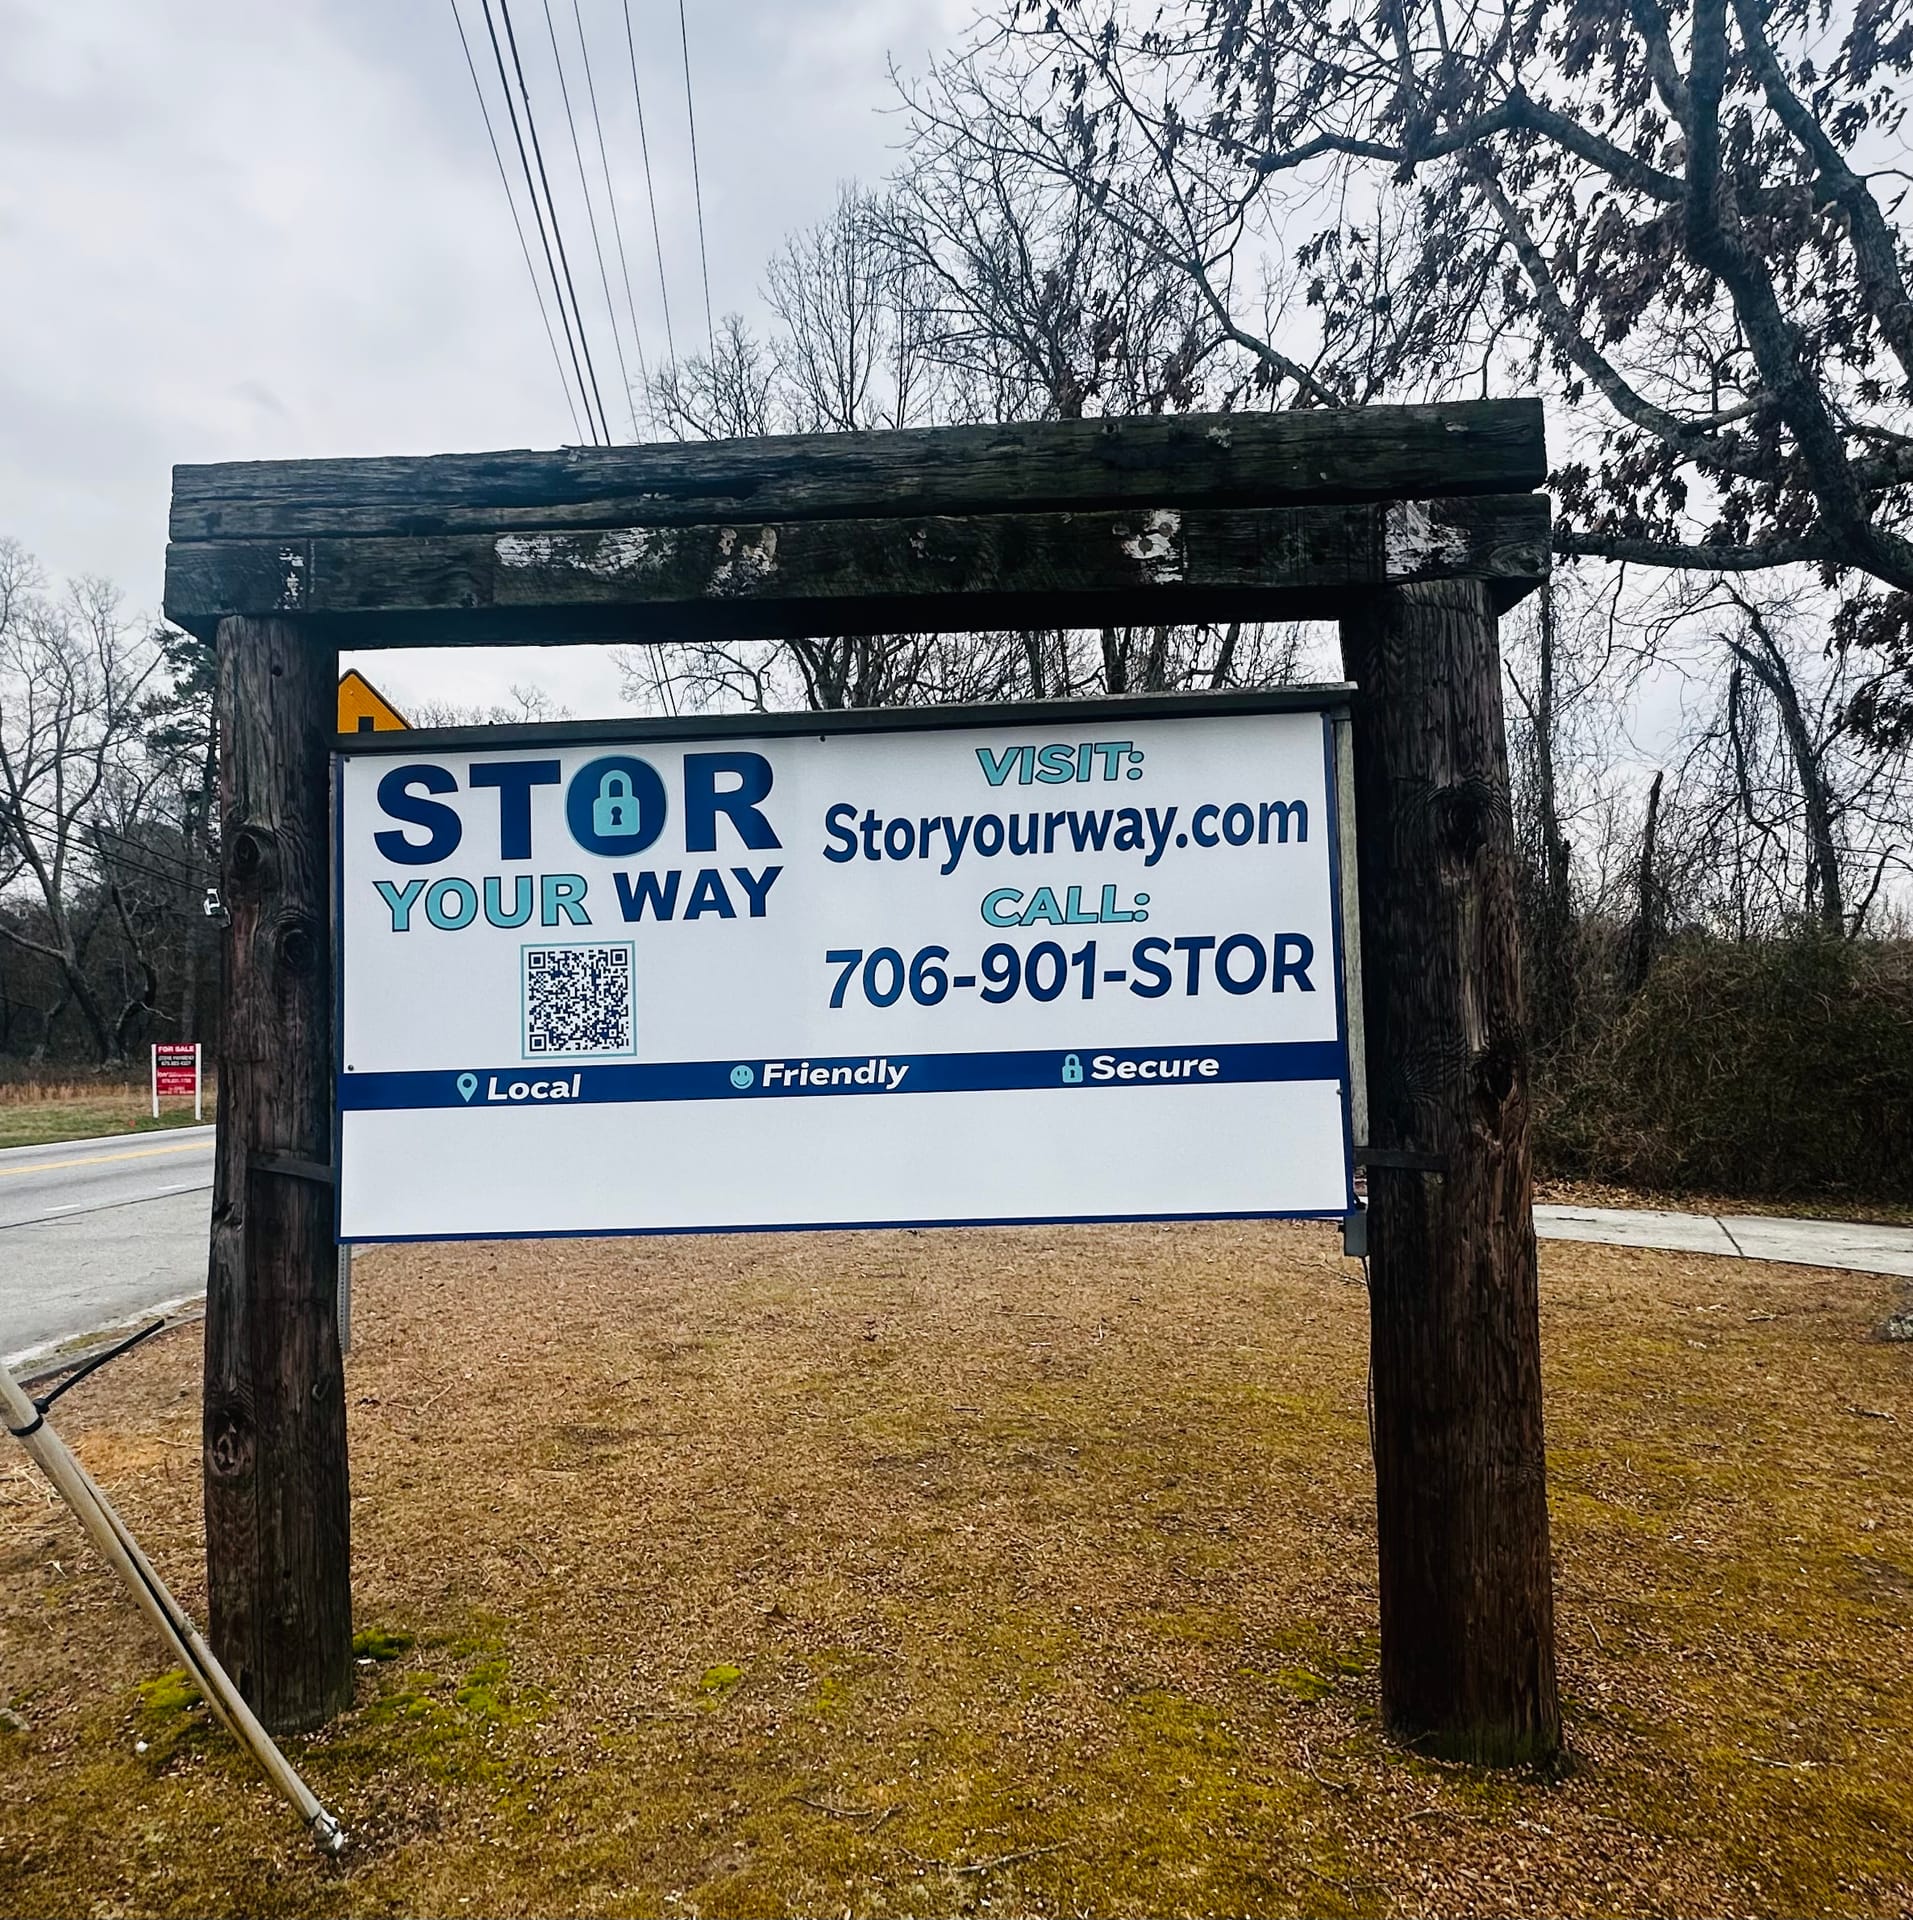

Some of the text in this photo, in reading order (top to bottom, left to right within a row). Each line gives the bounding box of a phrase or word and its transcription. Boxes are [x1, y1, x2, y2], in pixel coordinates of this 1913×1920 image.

[975, 741, 1145, 787] VISIT:
[373, 752, 783, 865] STOR
[823, 799, 1308, 875] Storyourway.com
[372, 866, 784, 933] YOUR WAY
[980, 884, 1151, 928] CALL:
[825, 933, 1316, 1009] 706-901-STOR
[487, 1074, 581, 1100] Local
[762, 1059, 909, 1090] Friendly
[1091, 1055, 1220, 1079] Secure
